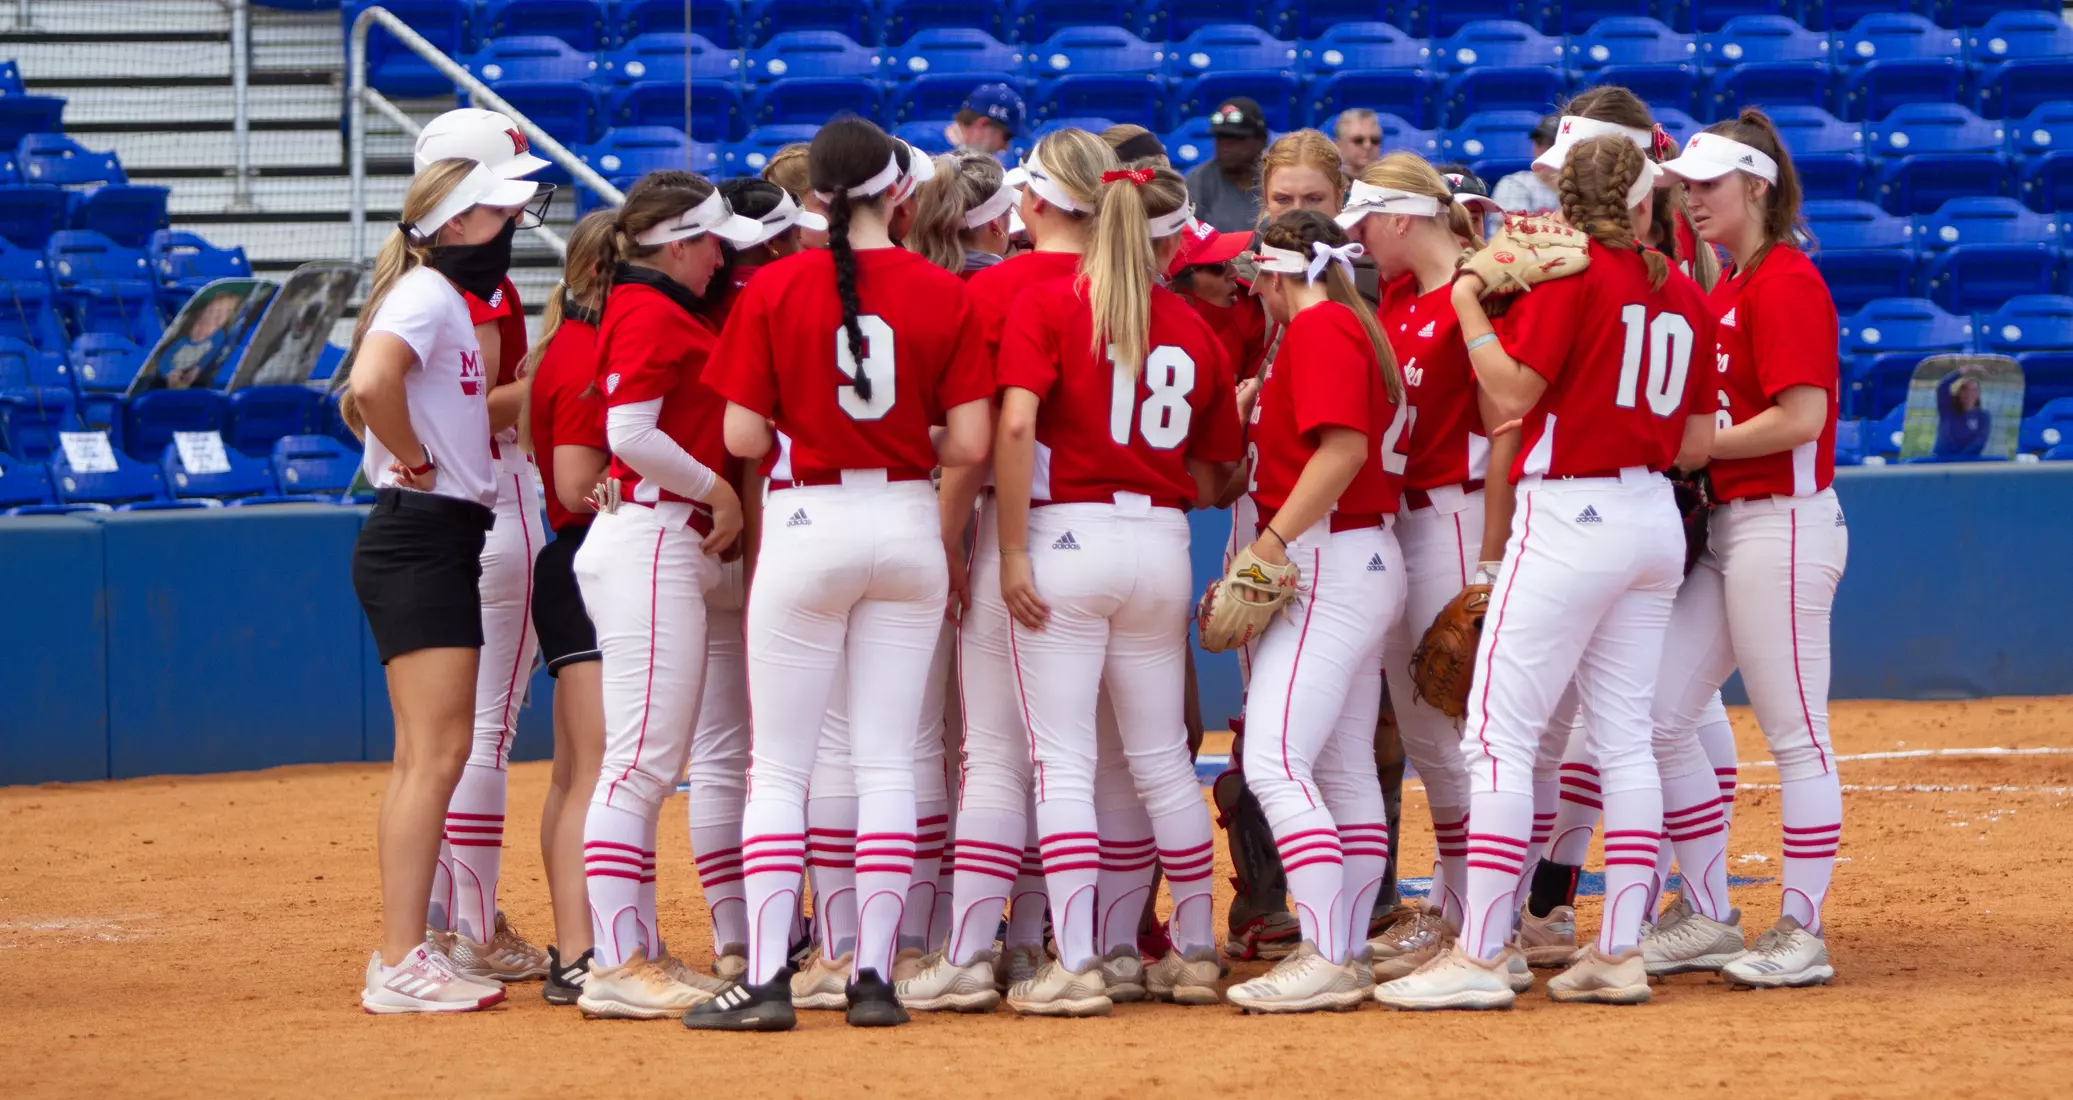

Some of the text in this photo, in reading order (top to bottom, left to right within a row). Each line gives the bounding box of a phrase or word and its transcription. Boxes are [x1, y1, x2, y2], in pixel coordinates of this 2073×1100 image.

[504, 124, 530, 156] M
[1561, 121, 1572, 134] M
[836, 312, 897, 421] 9
[1106, 342, 1197, 451] 18
[1615, 302, 1695, 418] 10
